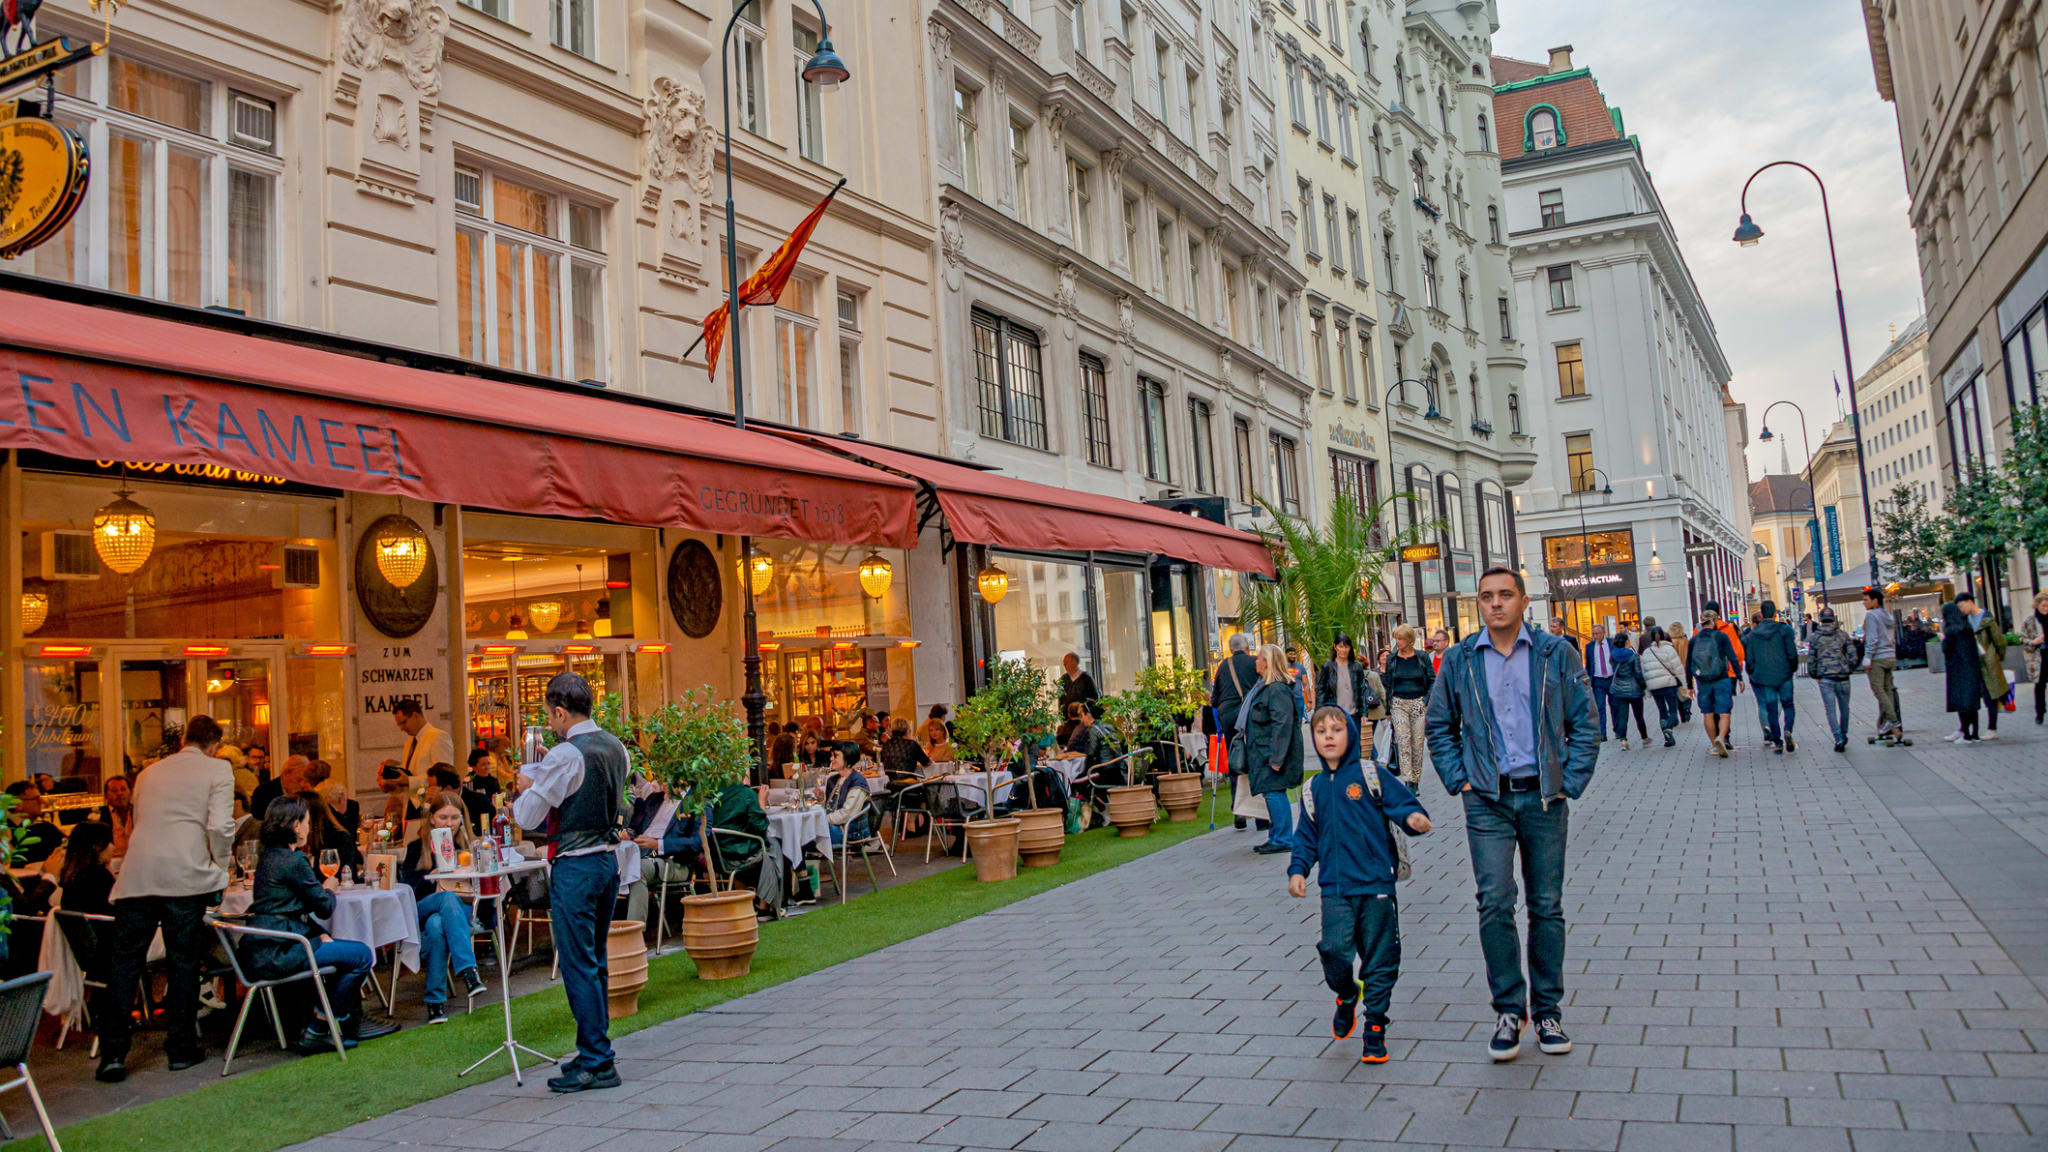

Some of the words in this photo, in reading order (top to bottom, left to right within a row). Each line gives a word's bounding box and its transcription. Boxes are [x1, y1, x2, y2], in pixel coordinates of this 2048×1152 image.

[0, 372, 133, 443] EN
[162, 394, 422, 482] KAMEEL
[699, 487, 809, 521] GEGRÜNDET
[815, 502, 846, 526] 1618
[383, 647, 411, 658] ZUM
[361, 667, 434, 683] SCHWARZEN
[365, 693, 434, 713] KAMEL
